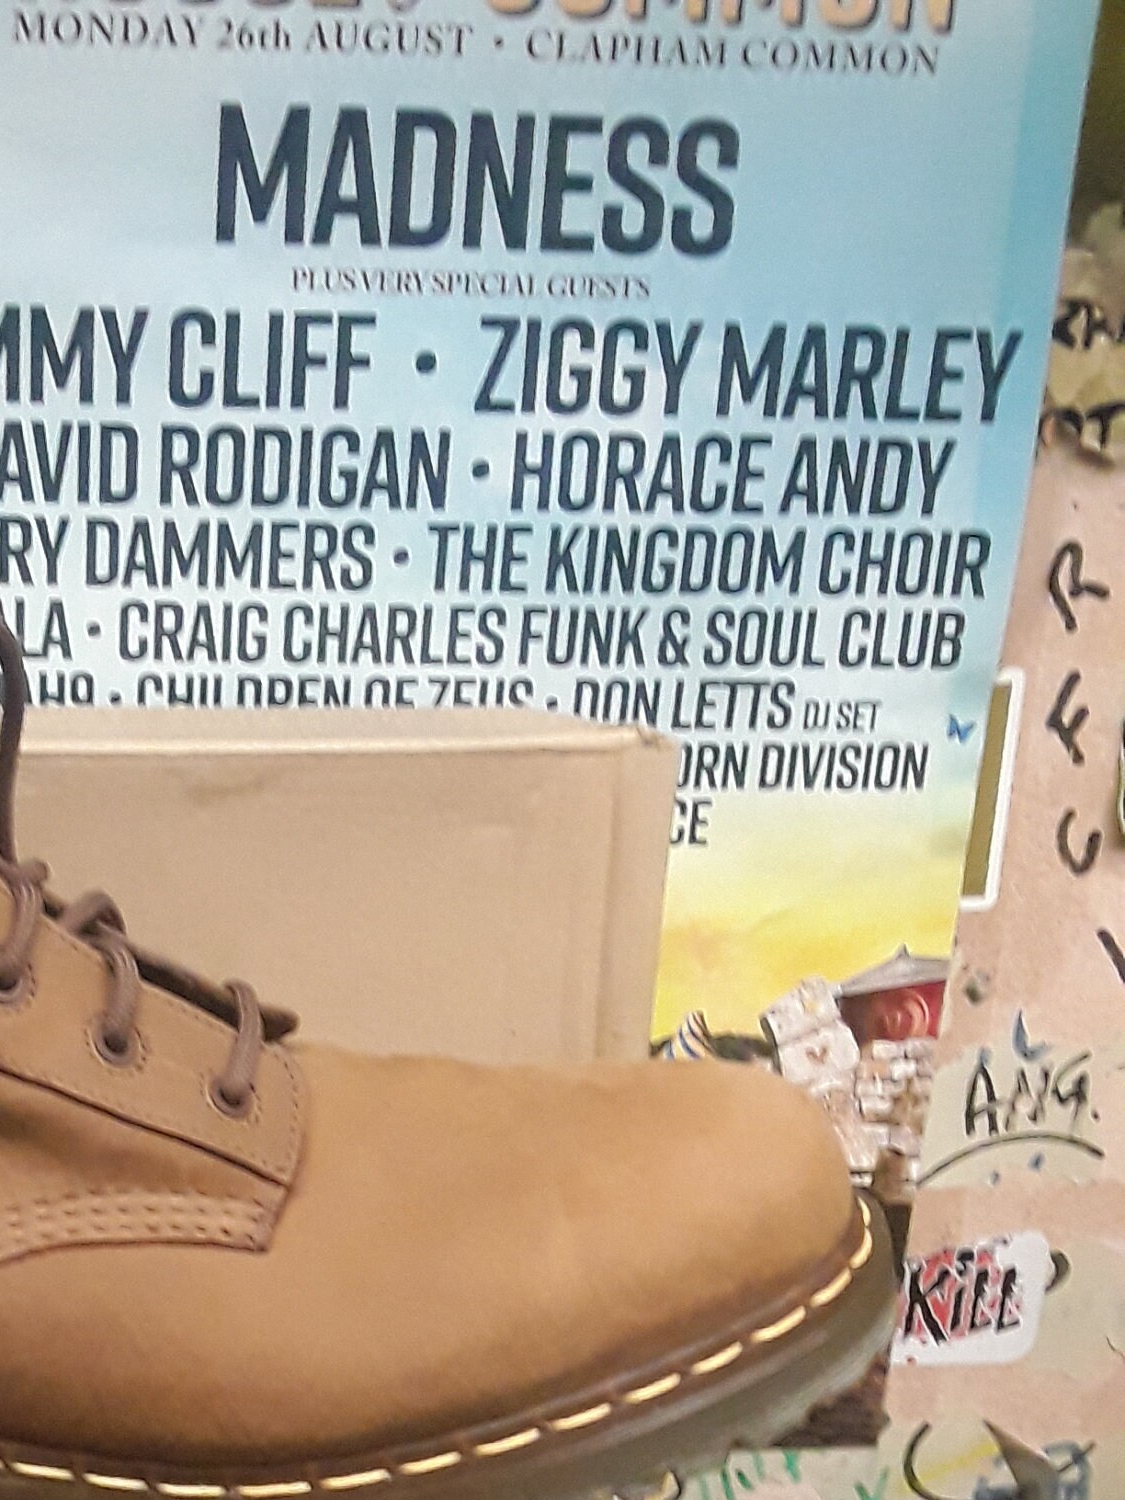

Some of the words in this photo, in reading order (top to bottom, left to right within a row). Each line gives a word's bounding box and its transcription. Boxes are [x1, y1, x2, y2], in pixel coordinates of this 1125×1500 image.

[13, 9, 203, 46] MONDAY
[217, 17, 291, 51] 26th
[306, 18, 474, 55] AUGUST
[526, 28, 726, 68] CLAPHAM
[742, 37, 939, 76] COMMON
[215, 101, 740, 257] MADNESS
[291, 265, 356, 293] PLUS
[360, 267, 425, 295] VERY
[430, 270, 537, 297] SPECIAL
[546, 272, 651, 299] GUESTS
[168, 308, 376, 411] CLIFF
[474, 316, 703, 417] ZIGGY
[716, 321, 1023, 425] MARLEY
[159, 423, 451, 511] RODIGAN
[510, 430, 773, 516] HORACE
[779, 435, 957, 517] ANDY
[85, 515, 376, 593] DAMMERS
[428, 523, 534, 594] THE
[543, 525, 807, 598] KINGDOM
[817, 529, 992, 601] CHOIR
[118, 600, 269, 663] CRAIG
[281, 601, 508, 667] CHARLES
[518, 606, 647, 667] FUNK
[656, 609, 691, 668] &
[703, 610, 826, 669] SOUL
[838, 611, 967, 671] CLUB
[574, 679, 661, 729] DON
[672, 679, 796, 732] LETTS
[803, 699, 830, 731] DJ
[836, 700, 882, 733] SET
[758, 742, 929, 792] DIVISION
